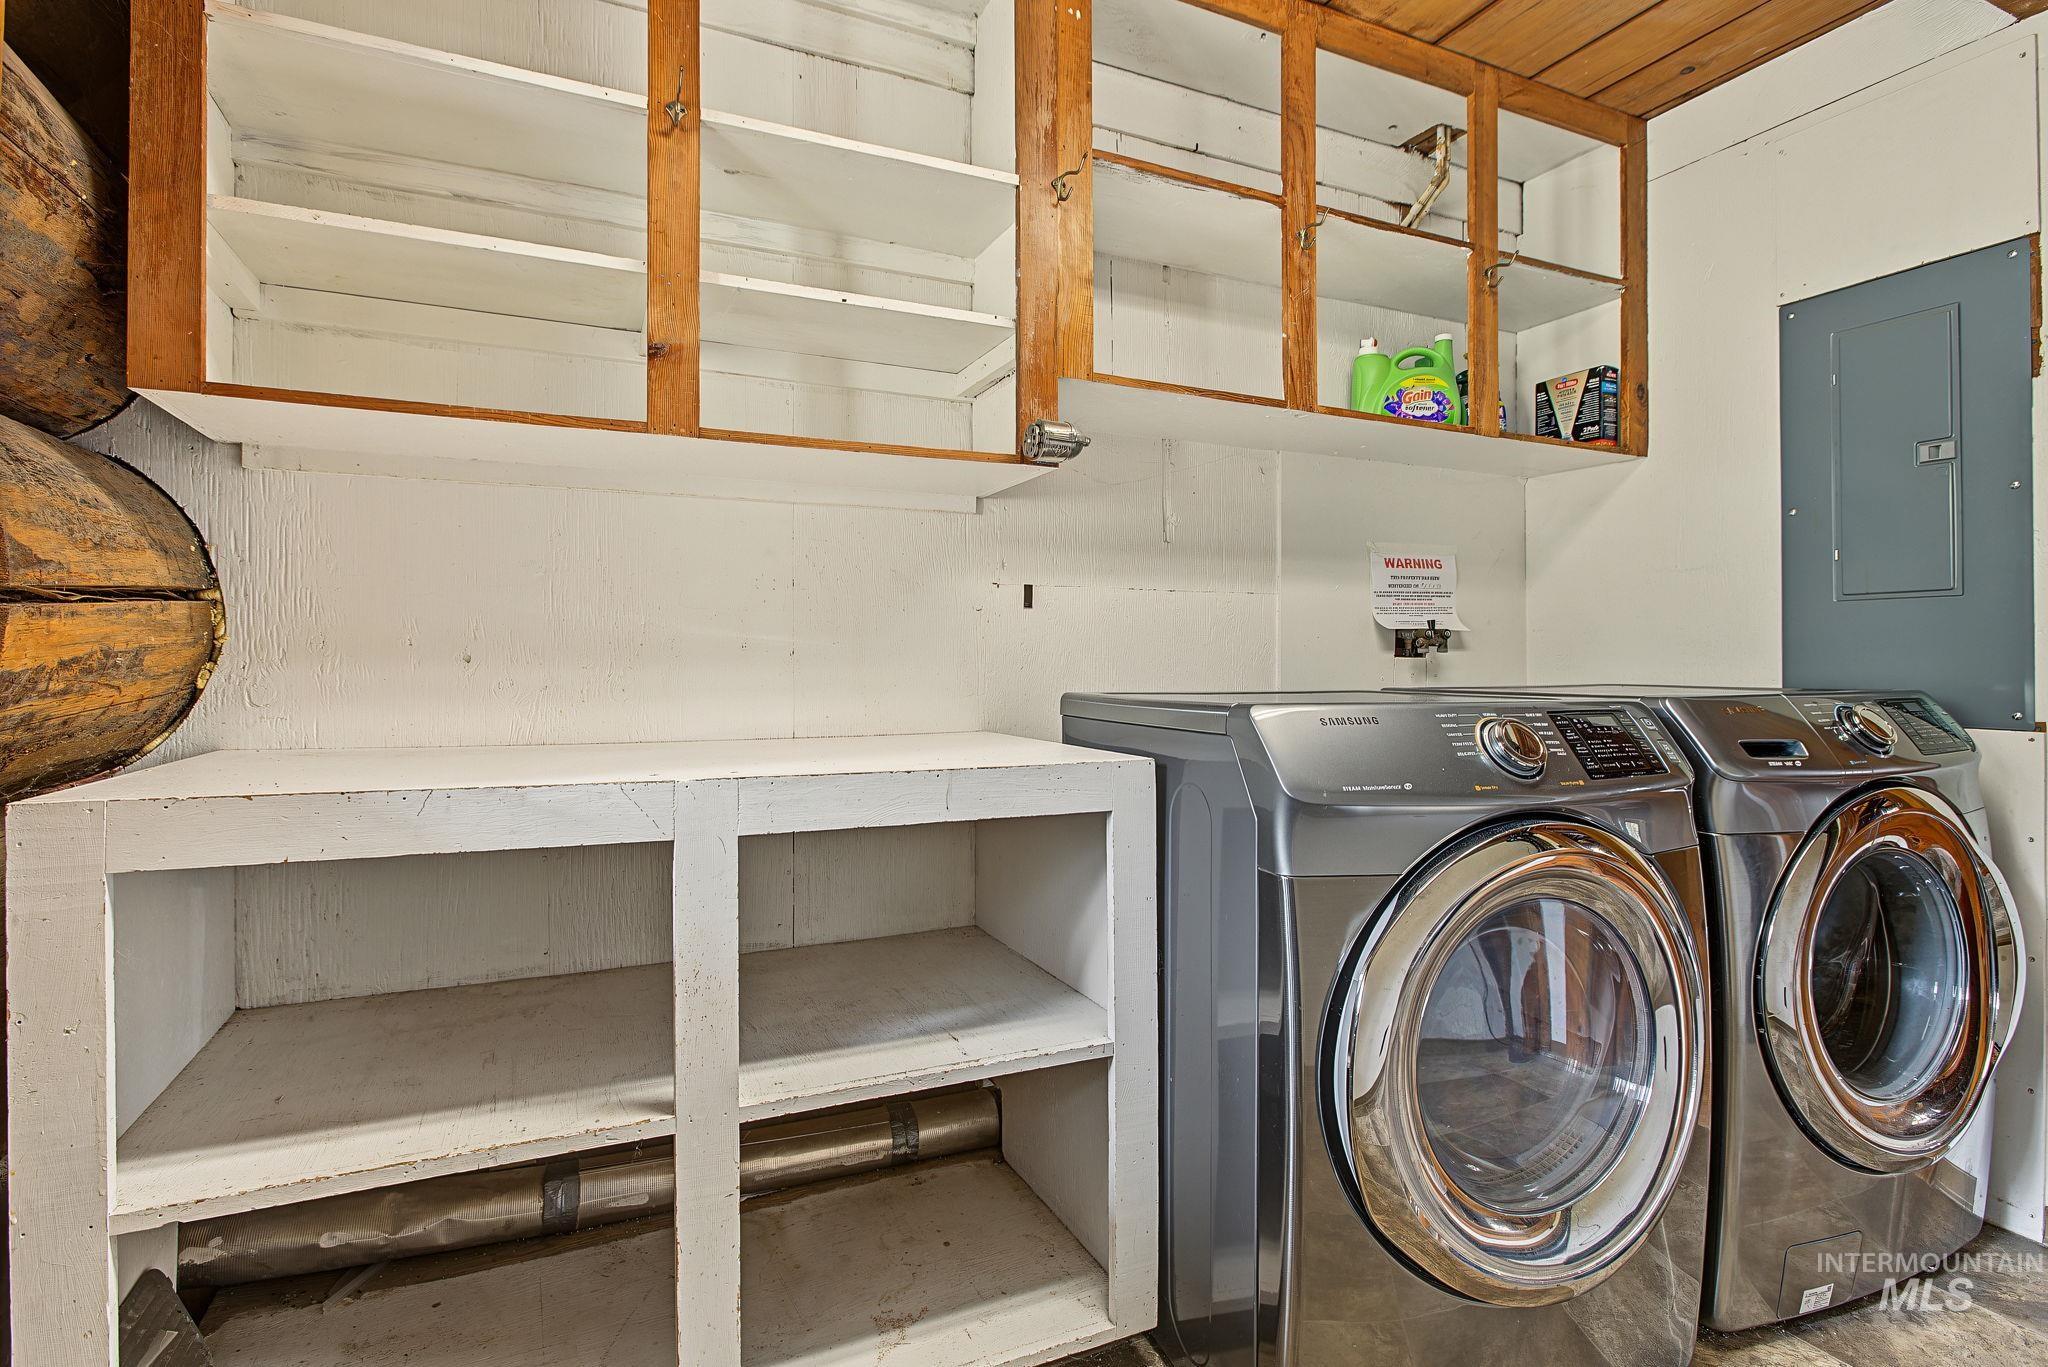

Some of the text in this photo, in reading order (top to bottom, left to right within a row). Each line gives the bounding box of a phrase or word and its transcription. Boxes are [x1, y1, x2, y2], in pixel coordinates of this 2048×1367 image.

[1402, 389, 1432, 404] Gain
[1384, 557, 1443, 569] WARNING
[1319, 716, 1380, 727] SAMSUNG
